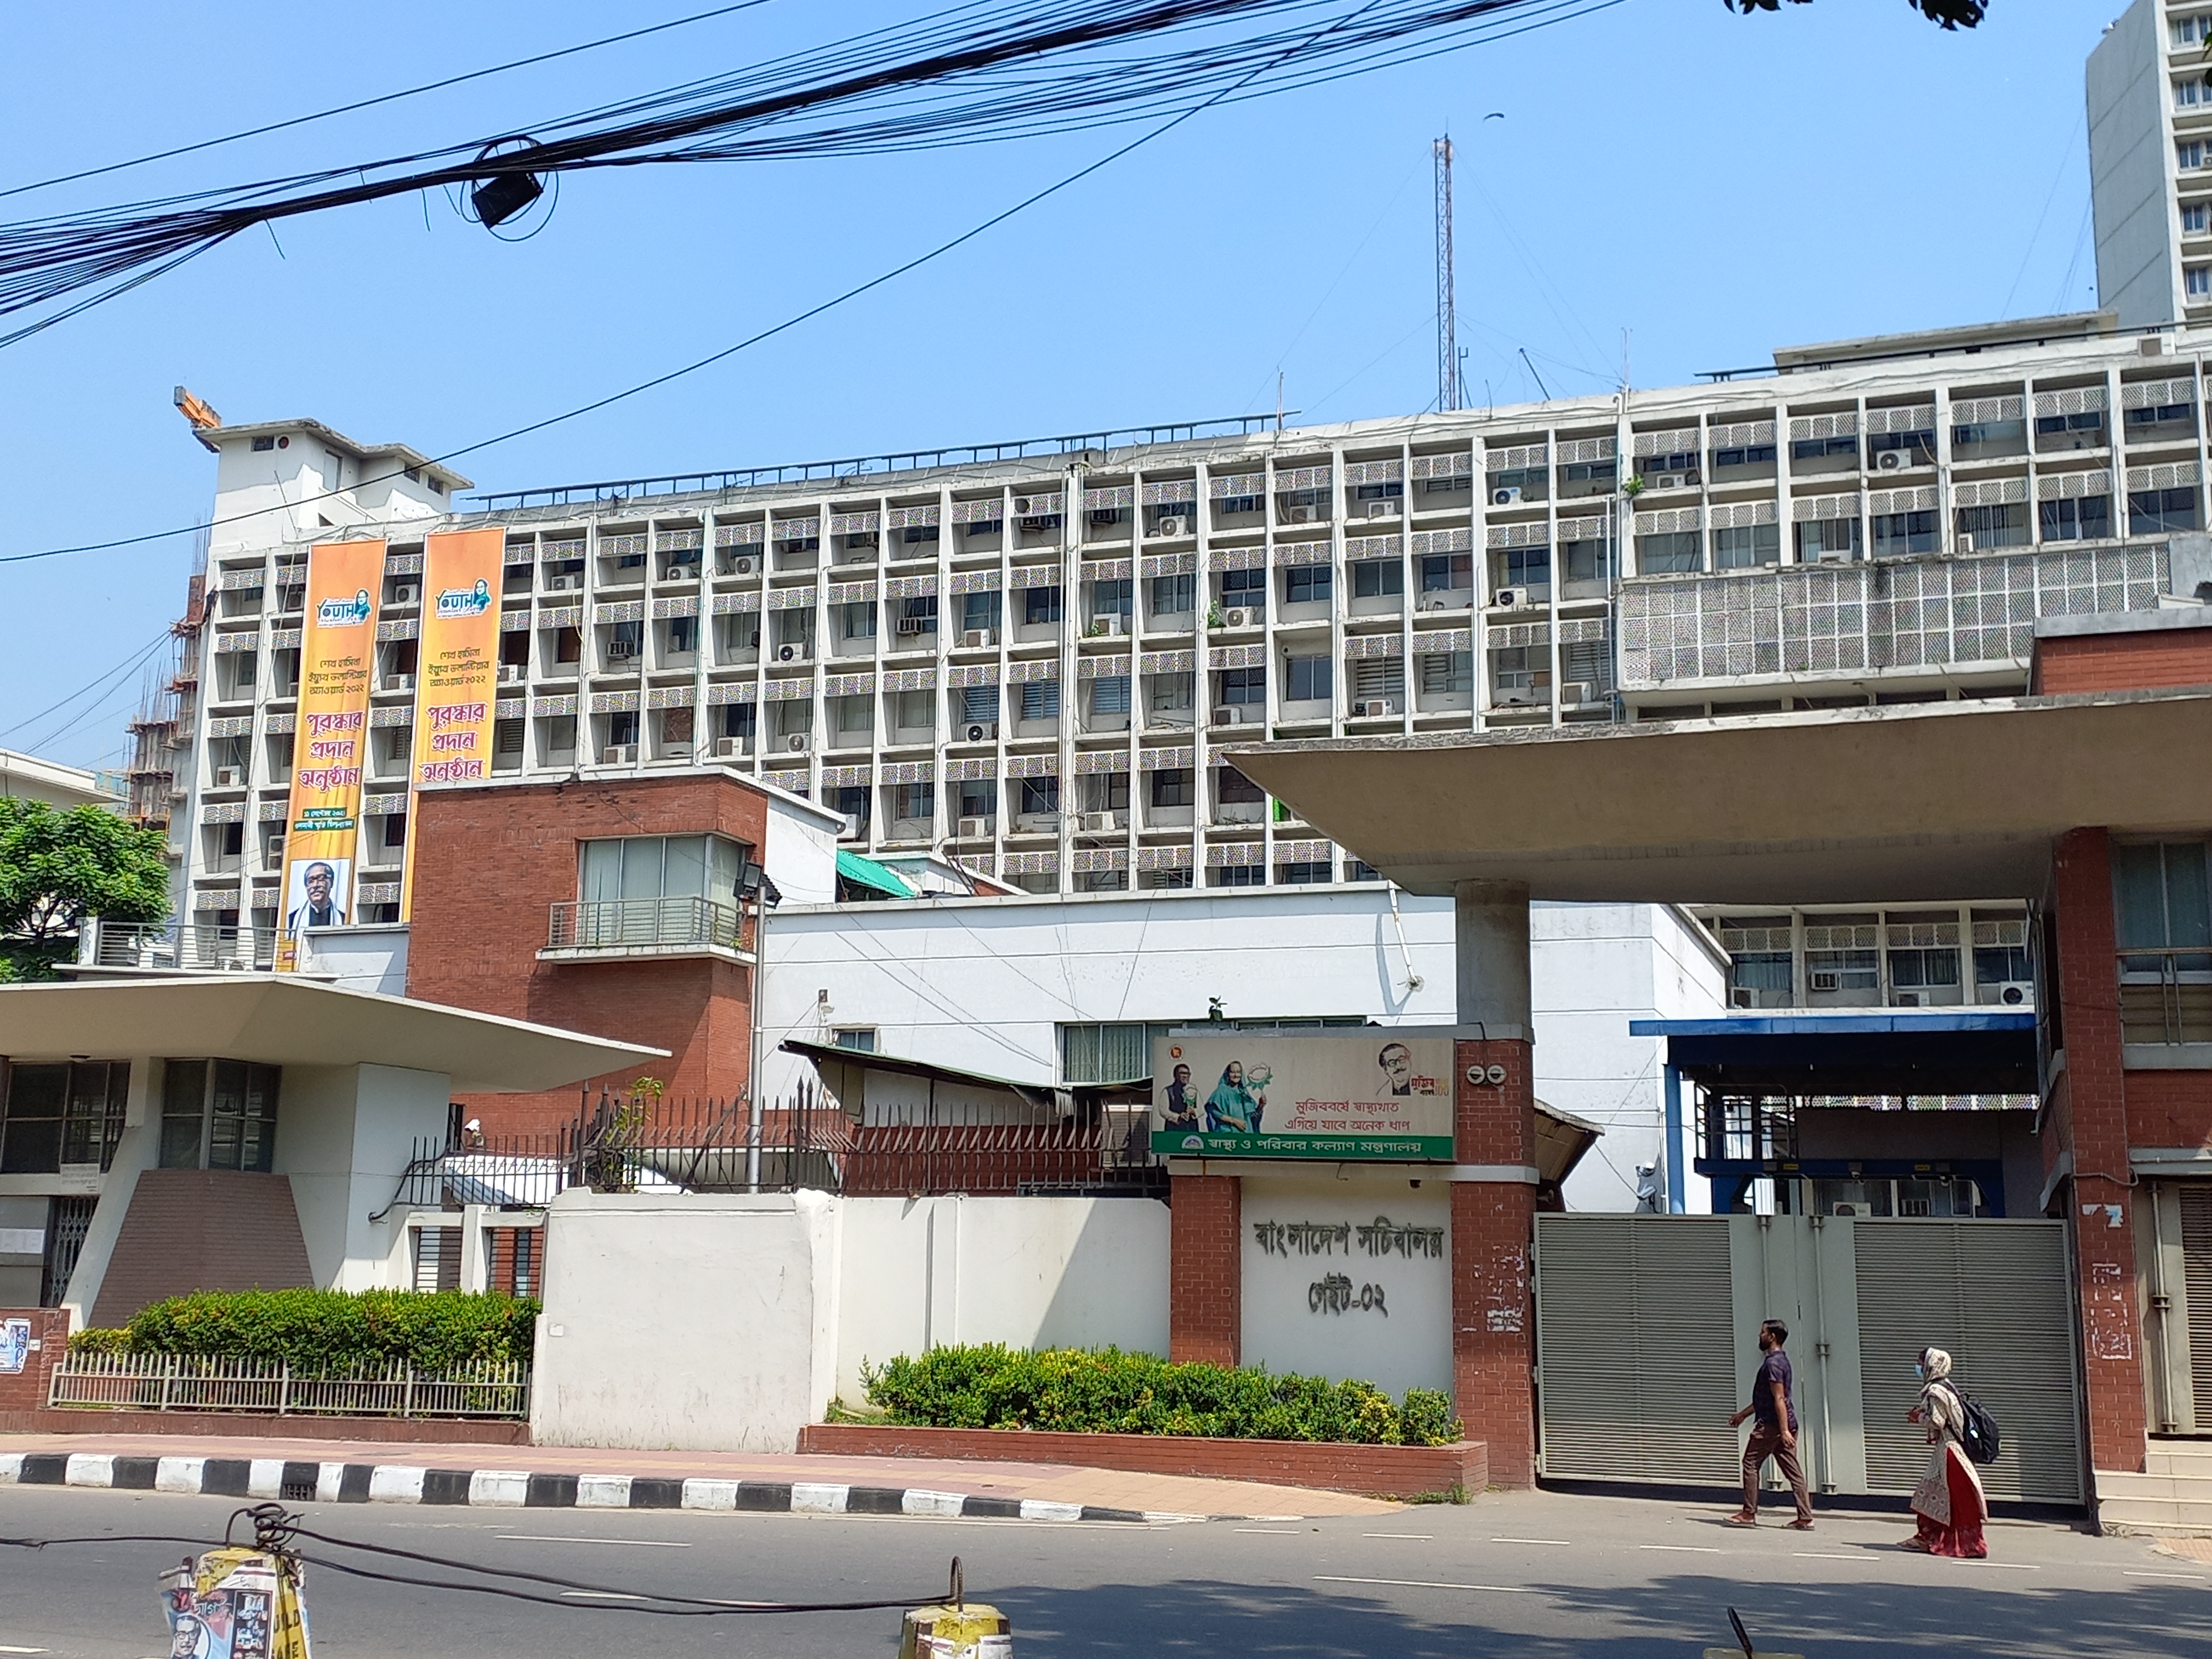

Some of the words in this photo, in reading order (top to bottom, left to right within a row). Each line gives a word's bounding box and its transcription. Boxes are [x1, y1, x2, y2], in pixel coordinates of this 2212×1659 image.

[435, 589, 473, 609] YOUTH
[317, 599, 354, 619] YOUTH
[320, 660, 337, 668] শেখ
[338, 656, 361, 667] হাসিনা
[440, 651, 456, 660] শেখ
[457, 647, 481, 659] হাসিনা
[465, 675, 486, 684] ২০২২
[306, 712, 363, 736] পুরস্কার
[427, 703, 486, 729] পুরস্কার
[311, 740, 354, 758] প্রদান
[433, 732, 476, 750] প্রদান
[299, 765, 359, 791] অনুষ্ঠান
[421, 757, 483, 781] অনুষ্ঠান
[1411, 1074, 1434, 1091] মুজিব
[1296, 1098, 1349, 1115] মুজিববর্ষে
[1353, 1102, 1400, 1115] স্বাস্থ্যখাত
[1285, 1117, 1317, 1130] এগিয়ে
[1321, 1120, 1347, 1130] যাবে
[1350, 1120, 1385, 1131] অনেক
[1389, 1121, 1410, 1131] ধাপ
[1207, 1139, 1237, 1151] স্বাস্থ্য
[1240, 1140, 1251, 1149] ও
[1257, 1138, 1307, 1150] পরিবার
[1311, 1141, 1355, 1151] কল্যাণ
[1360, 1141, 1422, 1153] মন্ত্রণালয়
[1253, 1219, 1352, 1259] বাংলাদেশ
[1355, 1216, 1445, 1259] সচিবালয়
